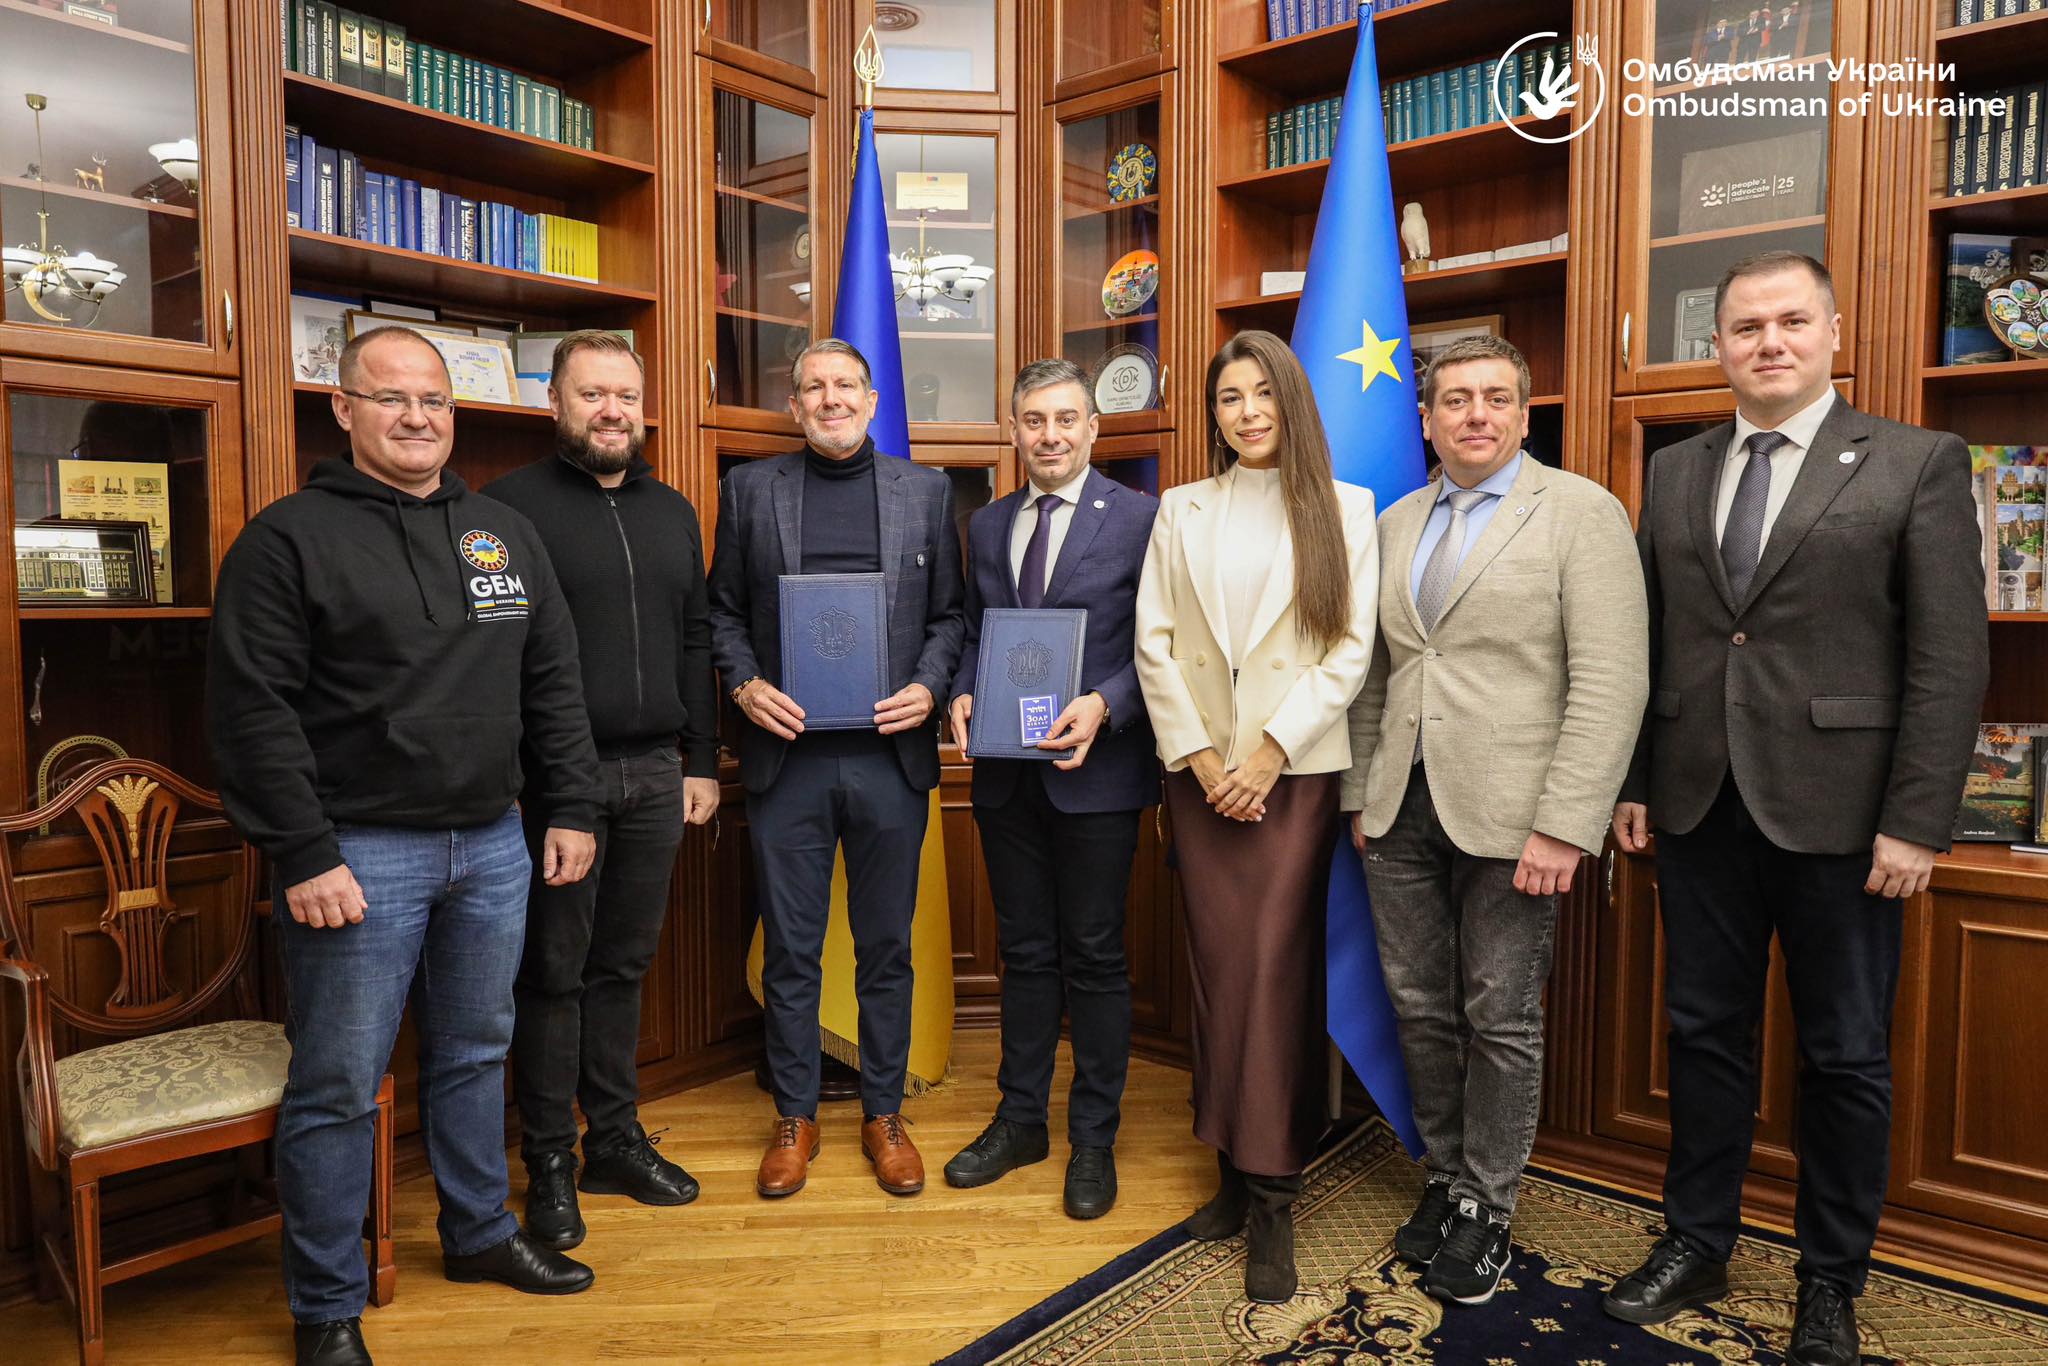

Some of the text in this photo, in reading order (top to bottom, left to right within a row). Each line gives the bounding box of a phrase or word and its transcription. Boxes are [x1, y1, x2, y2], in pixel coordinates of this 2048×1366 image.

[1777, 176, 1795, 189] 25
[1731, 185, 1770, 197] advocate
[469, 574, 526, 598] GEM
